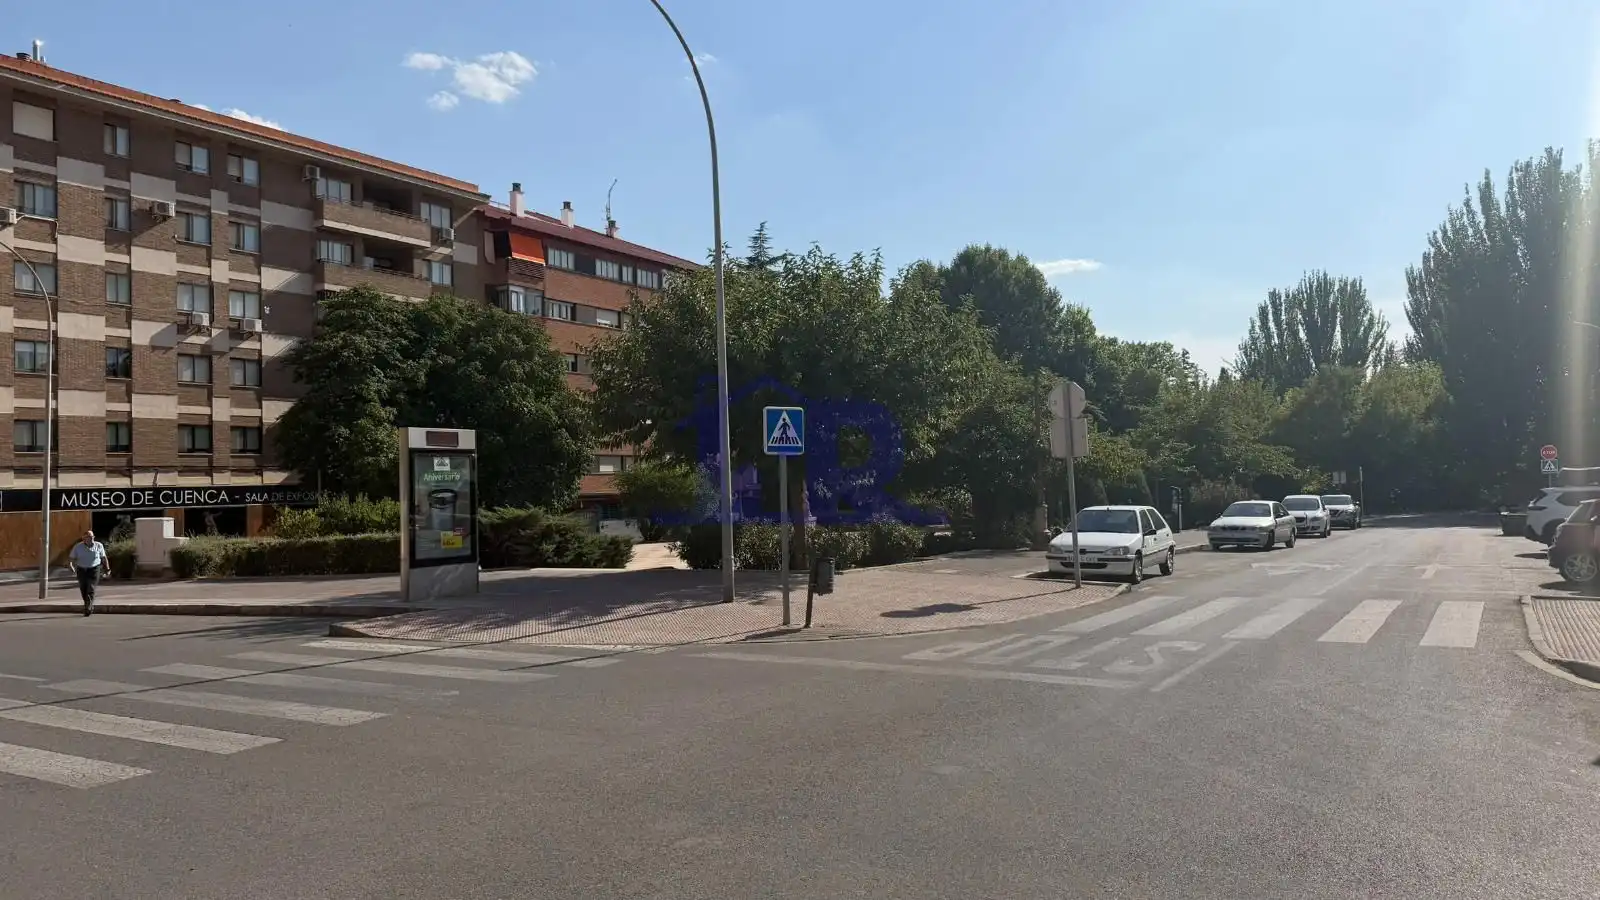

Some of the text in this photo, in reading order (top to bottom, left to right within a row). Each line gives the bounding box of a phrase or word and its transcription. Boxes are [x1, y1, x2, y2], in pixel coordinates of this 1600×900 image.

[423, 471, 461, 482] Aniversario
[60, 491, 126, 507] MUSEO
[131, 491, 154, 506] DE
[159, 488, 230, 505] CUENCA
[245, 492, 269, 502] SALA
[271, 491, 284, 501] DE
[902, 633, 1206, 674] STOP
